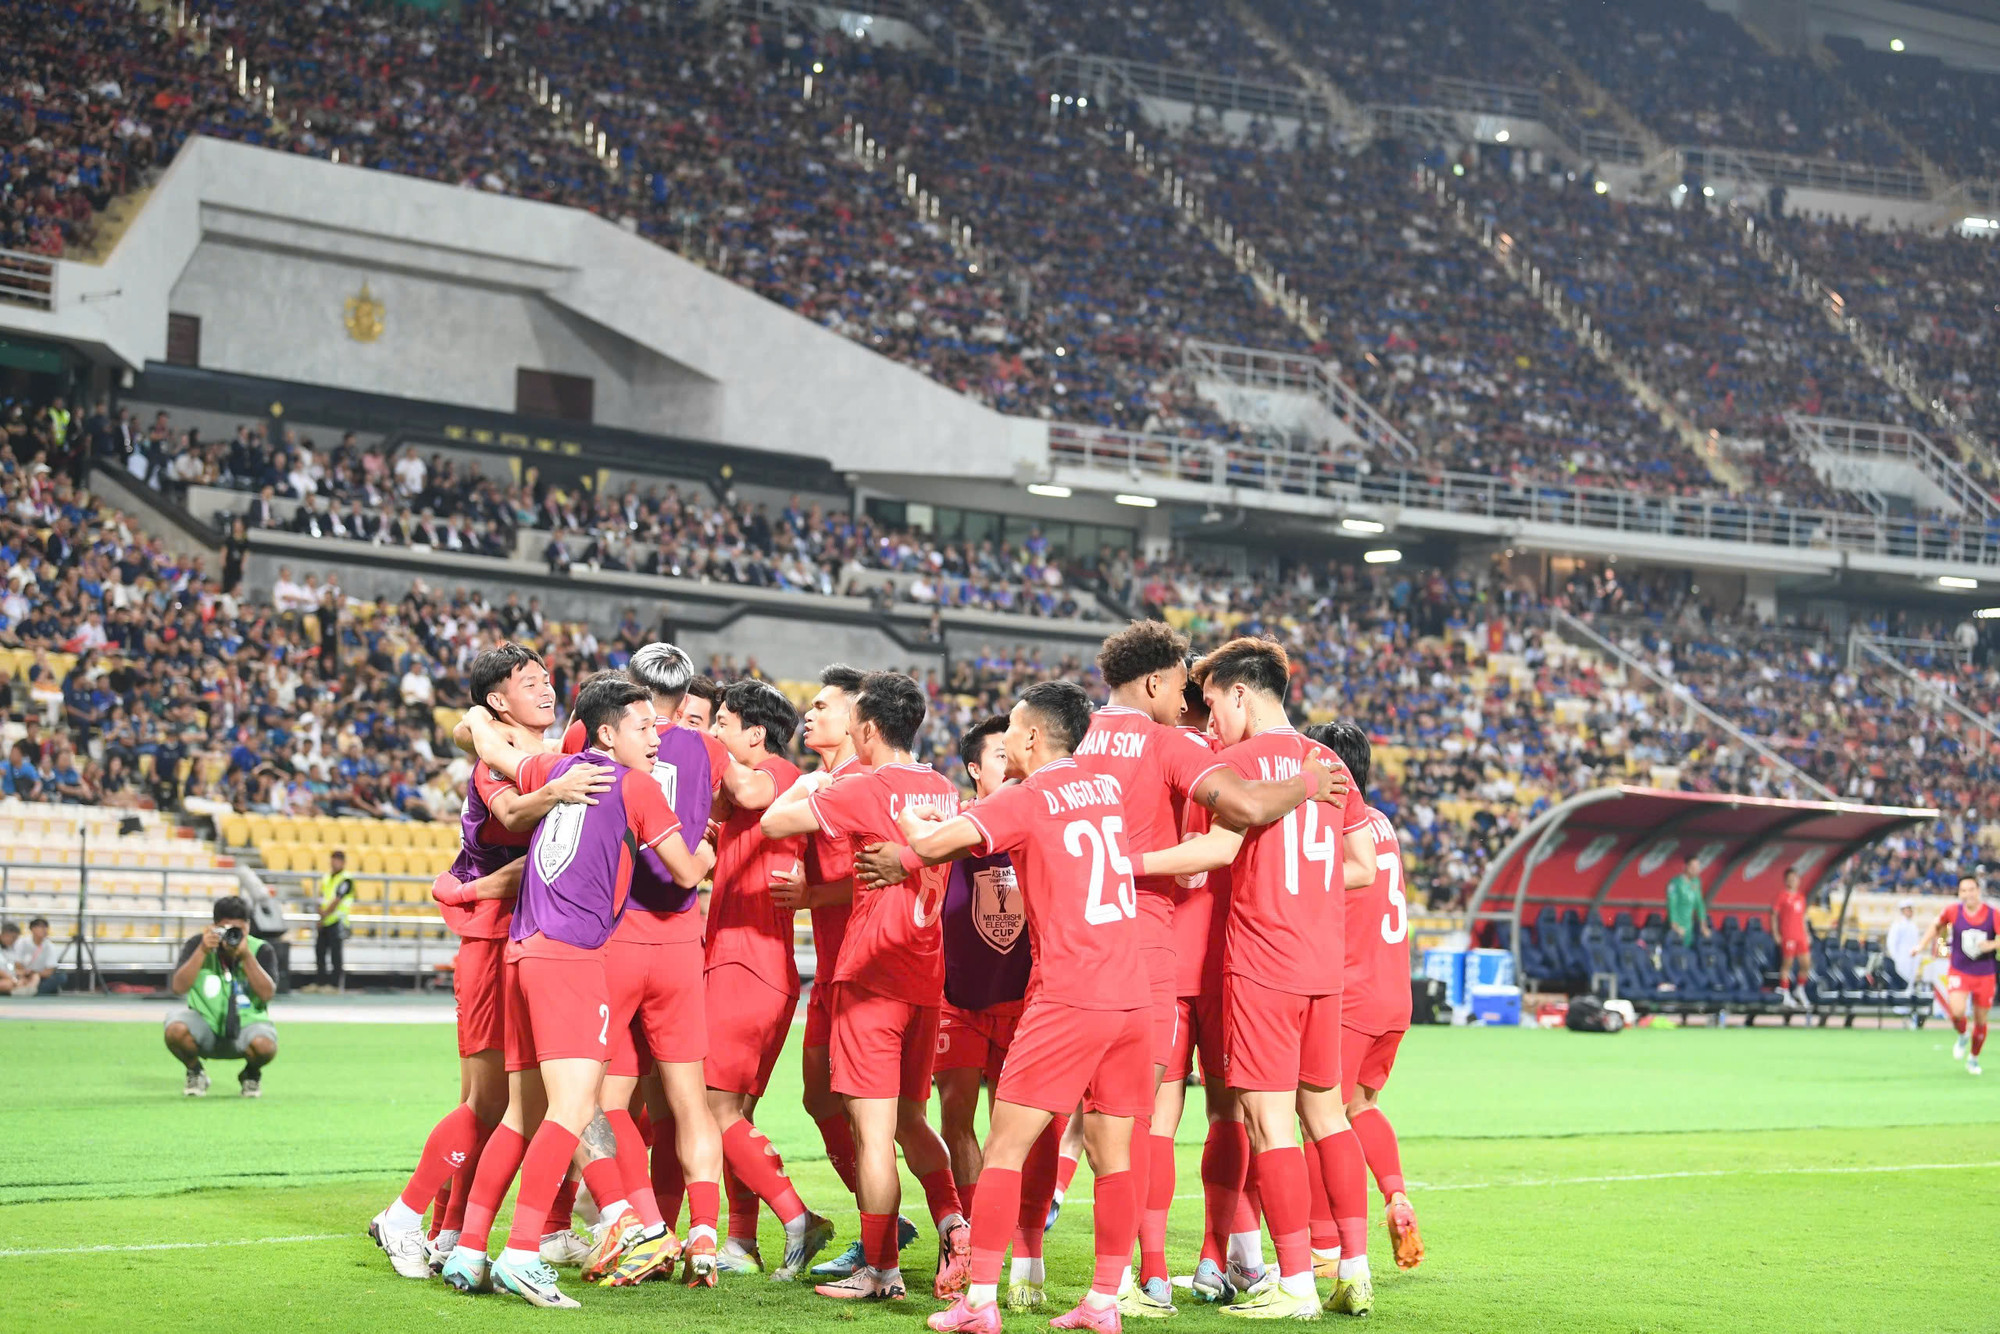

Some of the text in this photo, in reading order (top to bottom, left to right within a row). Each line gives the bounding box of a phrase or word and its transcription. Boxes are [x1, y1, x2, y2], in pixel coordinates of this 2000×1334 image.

[1072, 729, 1147, 758] UAN SON
[1042, 789, 1066, 815] D.
[1283, 799, 1335, 895] 14
[1063, 815, 1137, 926] 25
[983, 913, 1022, 921] MITSUBISHI
[985, 921, 1020, 929] ELECTRIC
[992, 929, 1014, 937] CUP
[598, 1003, 610, 1046] 2
